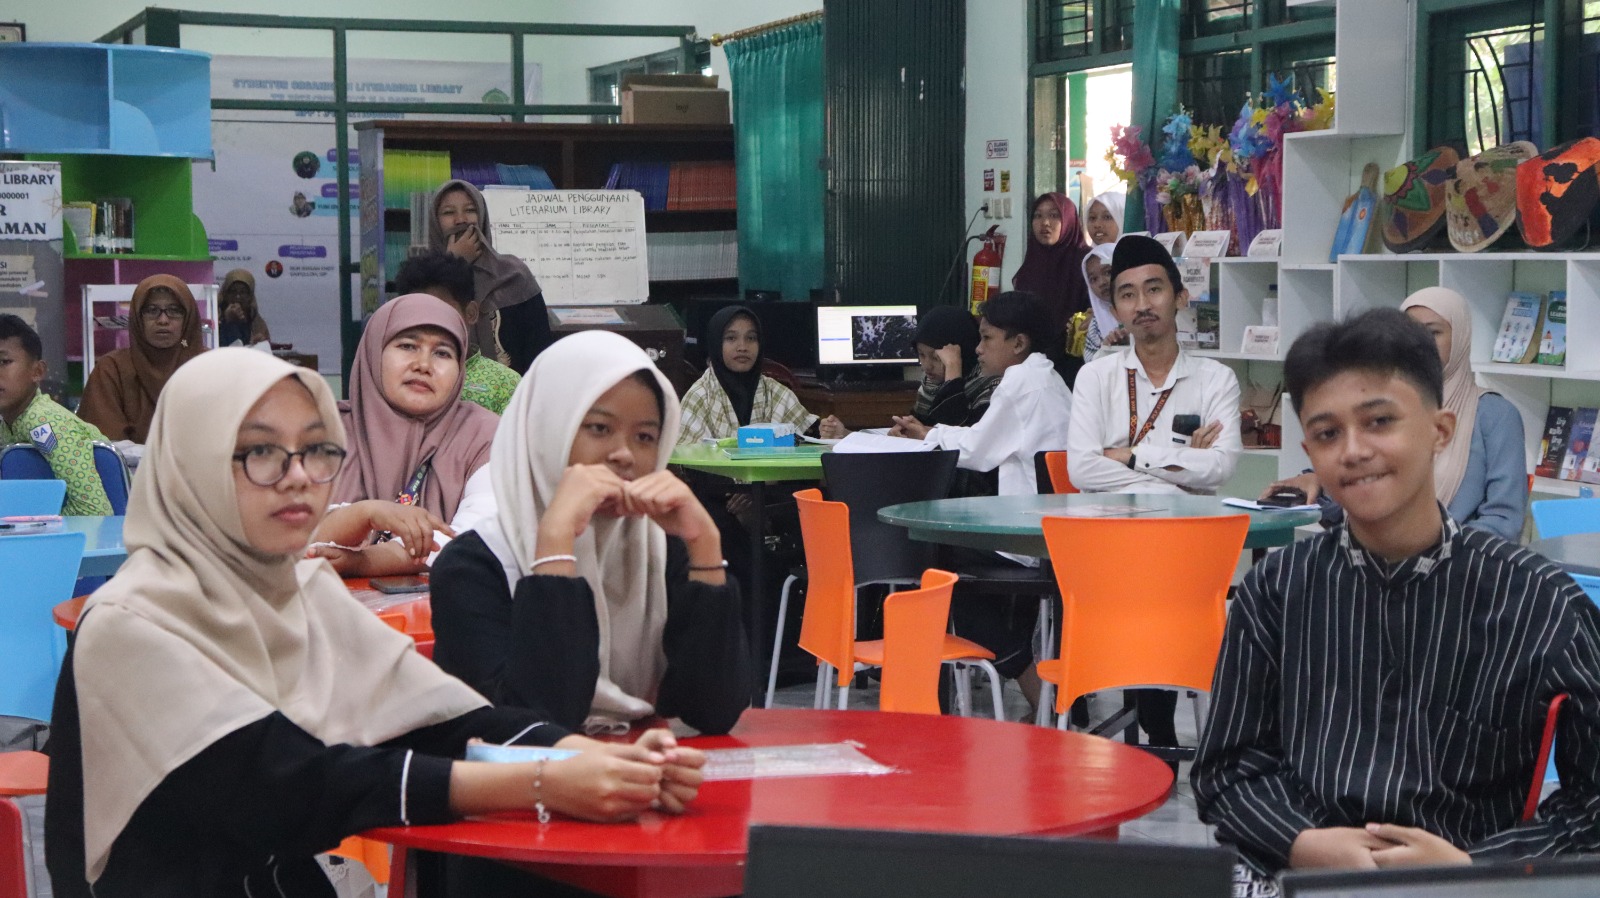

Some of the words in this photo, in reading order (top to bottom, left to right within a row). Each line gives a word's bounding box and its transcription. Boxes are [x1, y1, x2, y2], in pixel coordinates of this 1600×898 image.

[3, 174, 55, 185] LIBRARY
[525, 193, 564, 203] JADWAL
[567, 192, 630, 203] PENGGUNAAN
[510, 204, 568, 217] LITERARIUM
[573, 205, 611, 216] LIBRARY
[0, 222, 46, 235] MAN
[33, 427, 48, 439] 9A
